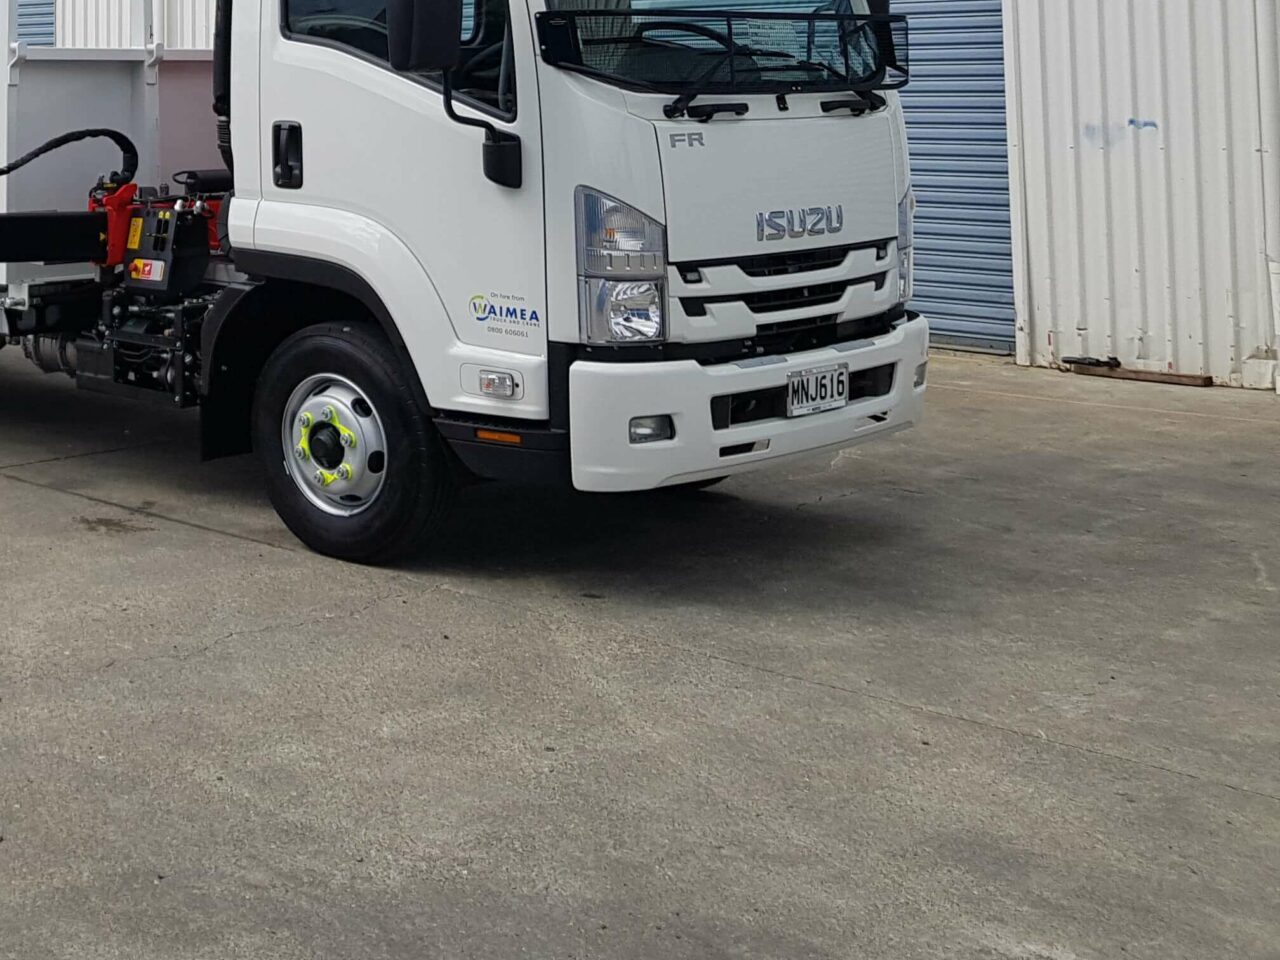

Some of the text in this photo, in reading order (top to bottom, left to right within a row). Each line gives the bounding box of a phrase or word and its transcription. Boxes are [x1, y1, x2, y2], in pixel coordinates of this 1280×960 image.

[669, 132, 705, 148] FR
[756, 205, 843, 241] ISUZU
[471, 300, 540, 322] WAIMEA
[791, 371, 845, 407] MNJ616
